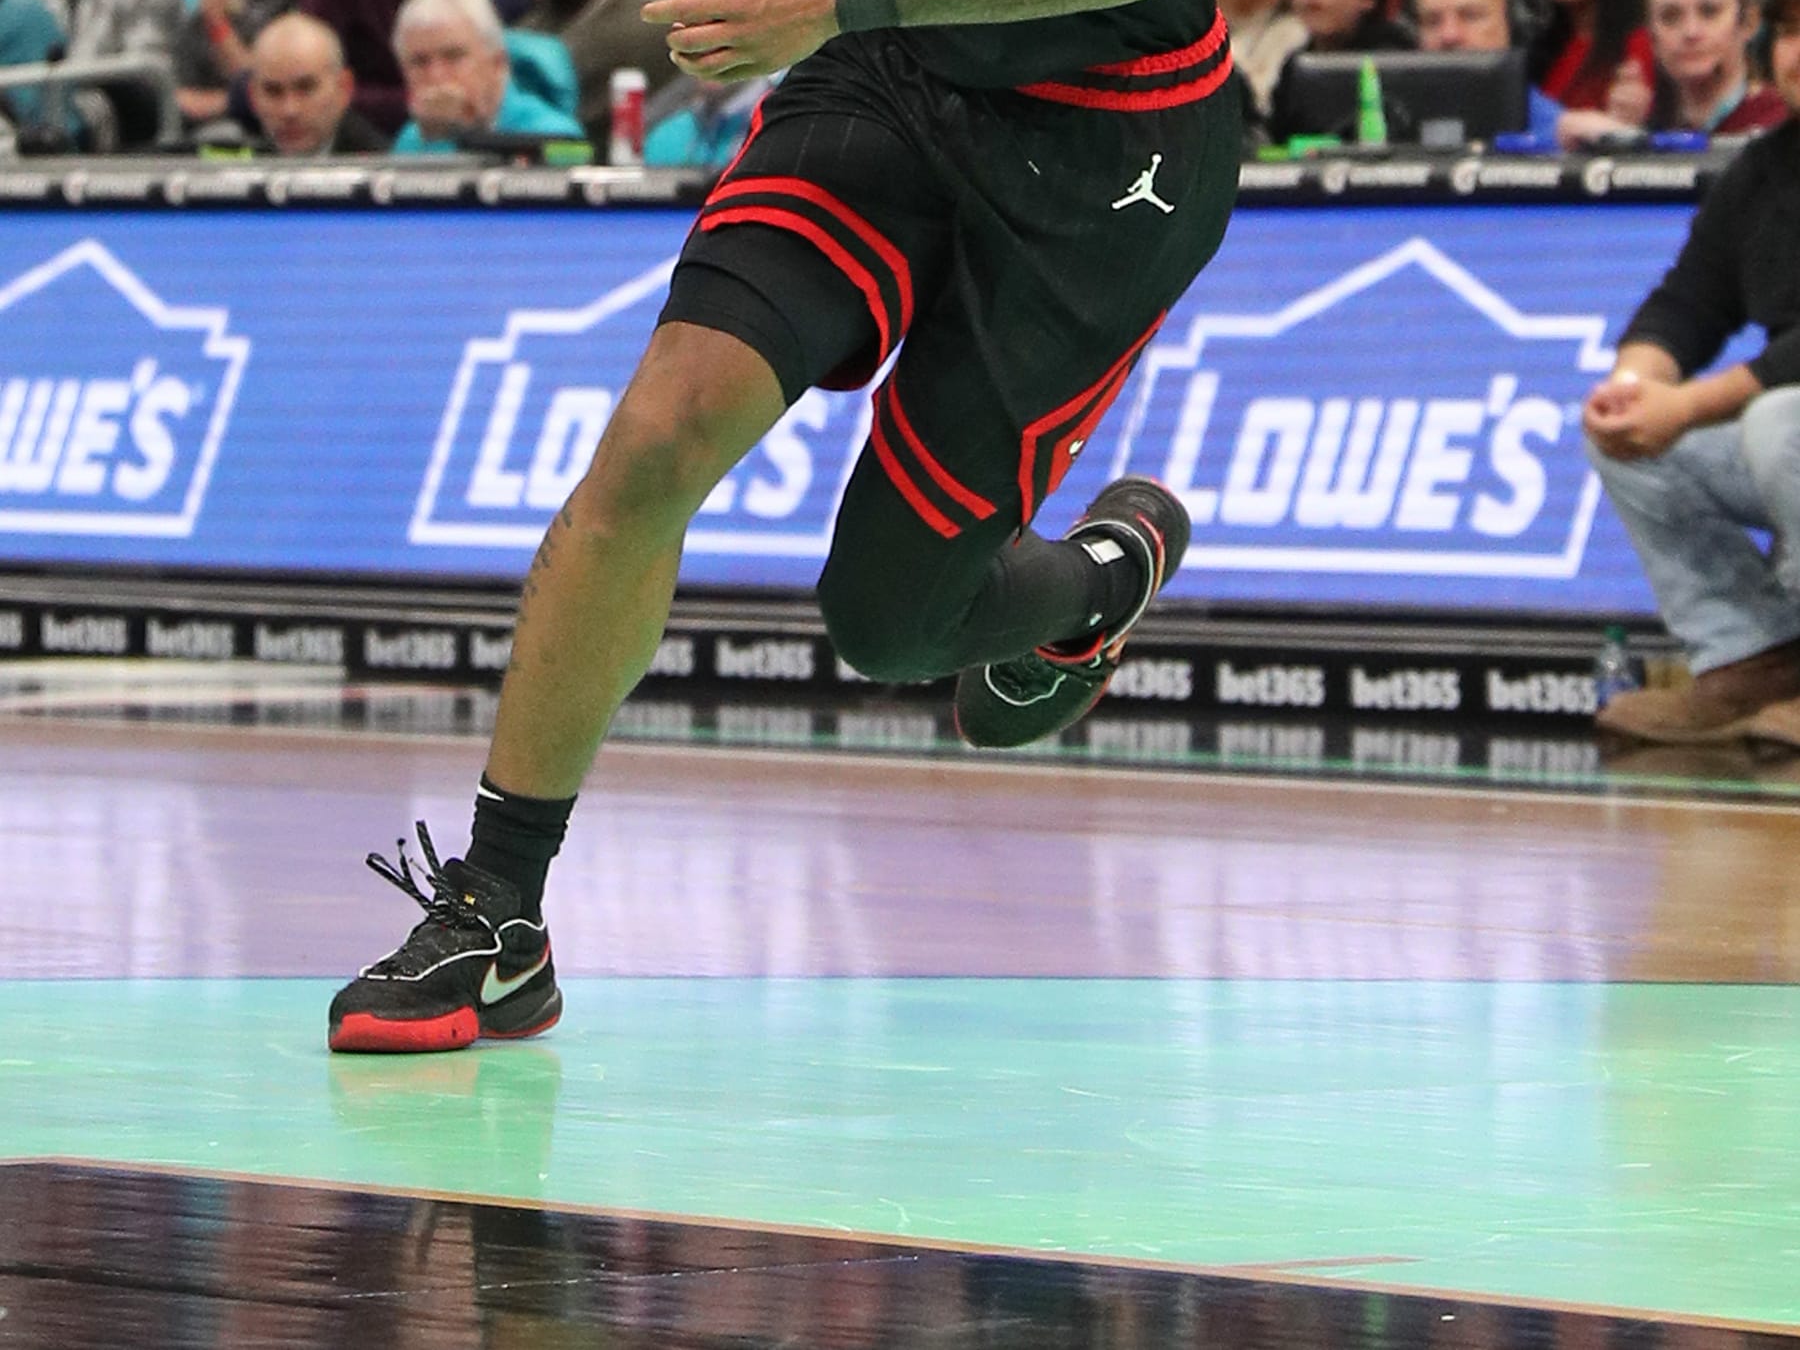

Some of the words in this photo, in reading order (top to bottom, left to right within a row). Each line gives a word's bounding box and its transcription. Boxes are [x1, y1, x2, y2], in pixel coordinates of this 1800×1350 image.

[0, 356, 193, 502] WE'S
[464, 362, 829, 519] LOS
[1161, 371, 1563, 537] LOWE'S
[1107, 659, 1193, 700] et365
[1216, 660, 1326, 707] bet365
[1350, 665, 1461, 710] bet365
[1487, 666, 1598, 714] bet365
